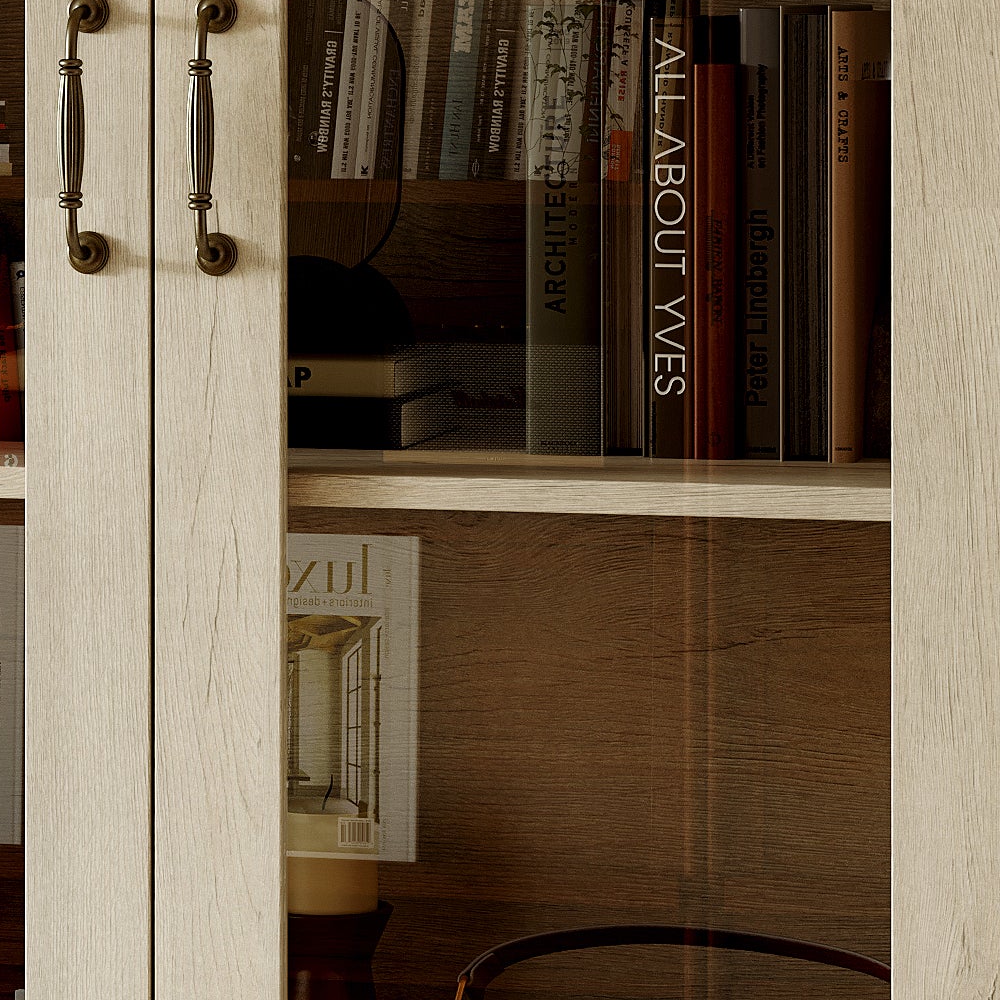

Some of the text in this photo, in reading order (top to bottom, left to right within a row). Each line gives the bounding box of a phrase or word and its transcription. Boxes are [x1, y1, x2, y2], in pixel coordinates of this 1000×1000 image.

[544, 54, 568, 315] ARCHITECTURE
[654, 37, 687, 397] ALL ABOUT YVES
[837, 46, 849, 163] ARTS & CRAFTS
[744, 209, 775, 408] Peter Lindbergh
